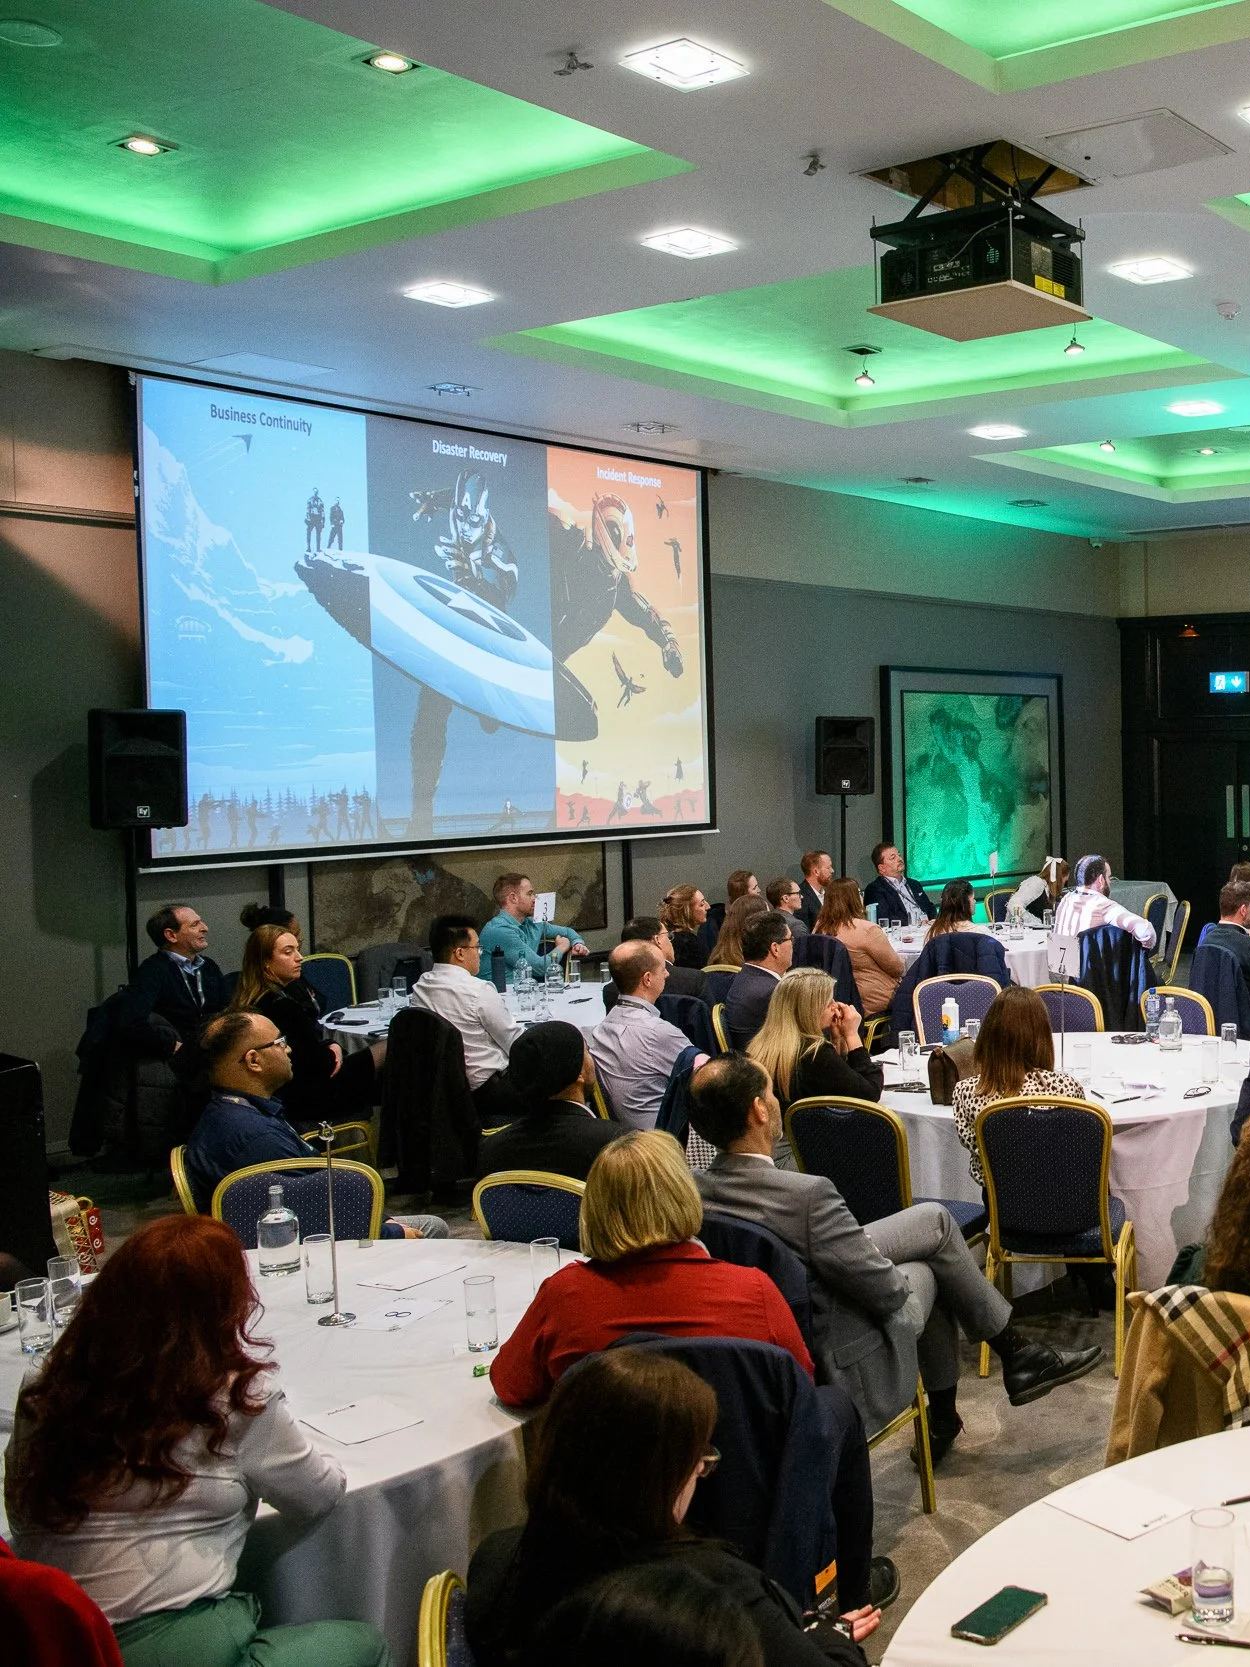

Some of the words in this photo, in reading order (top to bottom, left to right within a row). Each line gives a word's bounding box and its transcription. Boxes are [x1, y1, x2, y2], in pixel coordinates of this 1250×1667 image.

[210, 404, 257, 424] Business
[260, 412, 313, 436] Continuity
[432, 440, 468, 458] Disaster
[469, 445, 508, 467] Recovery
[597, 466, 627, 483] Incident
[628, 471, 662, 488] Response
[542, 902, 548, 915] 3
[1059, 947, 1066, 964] 7
